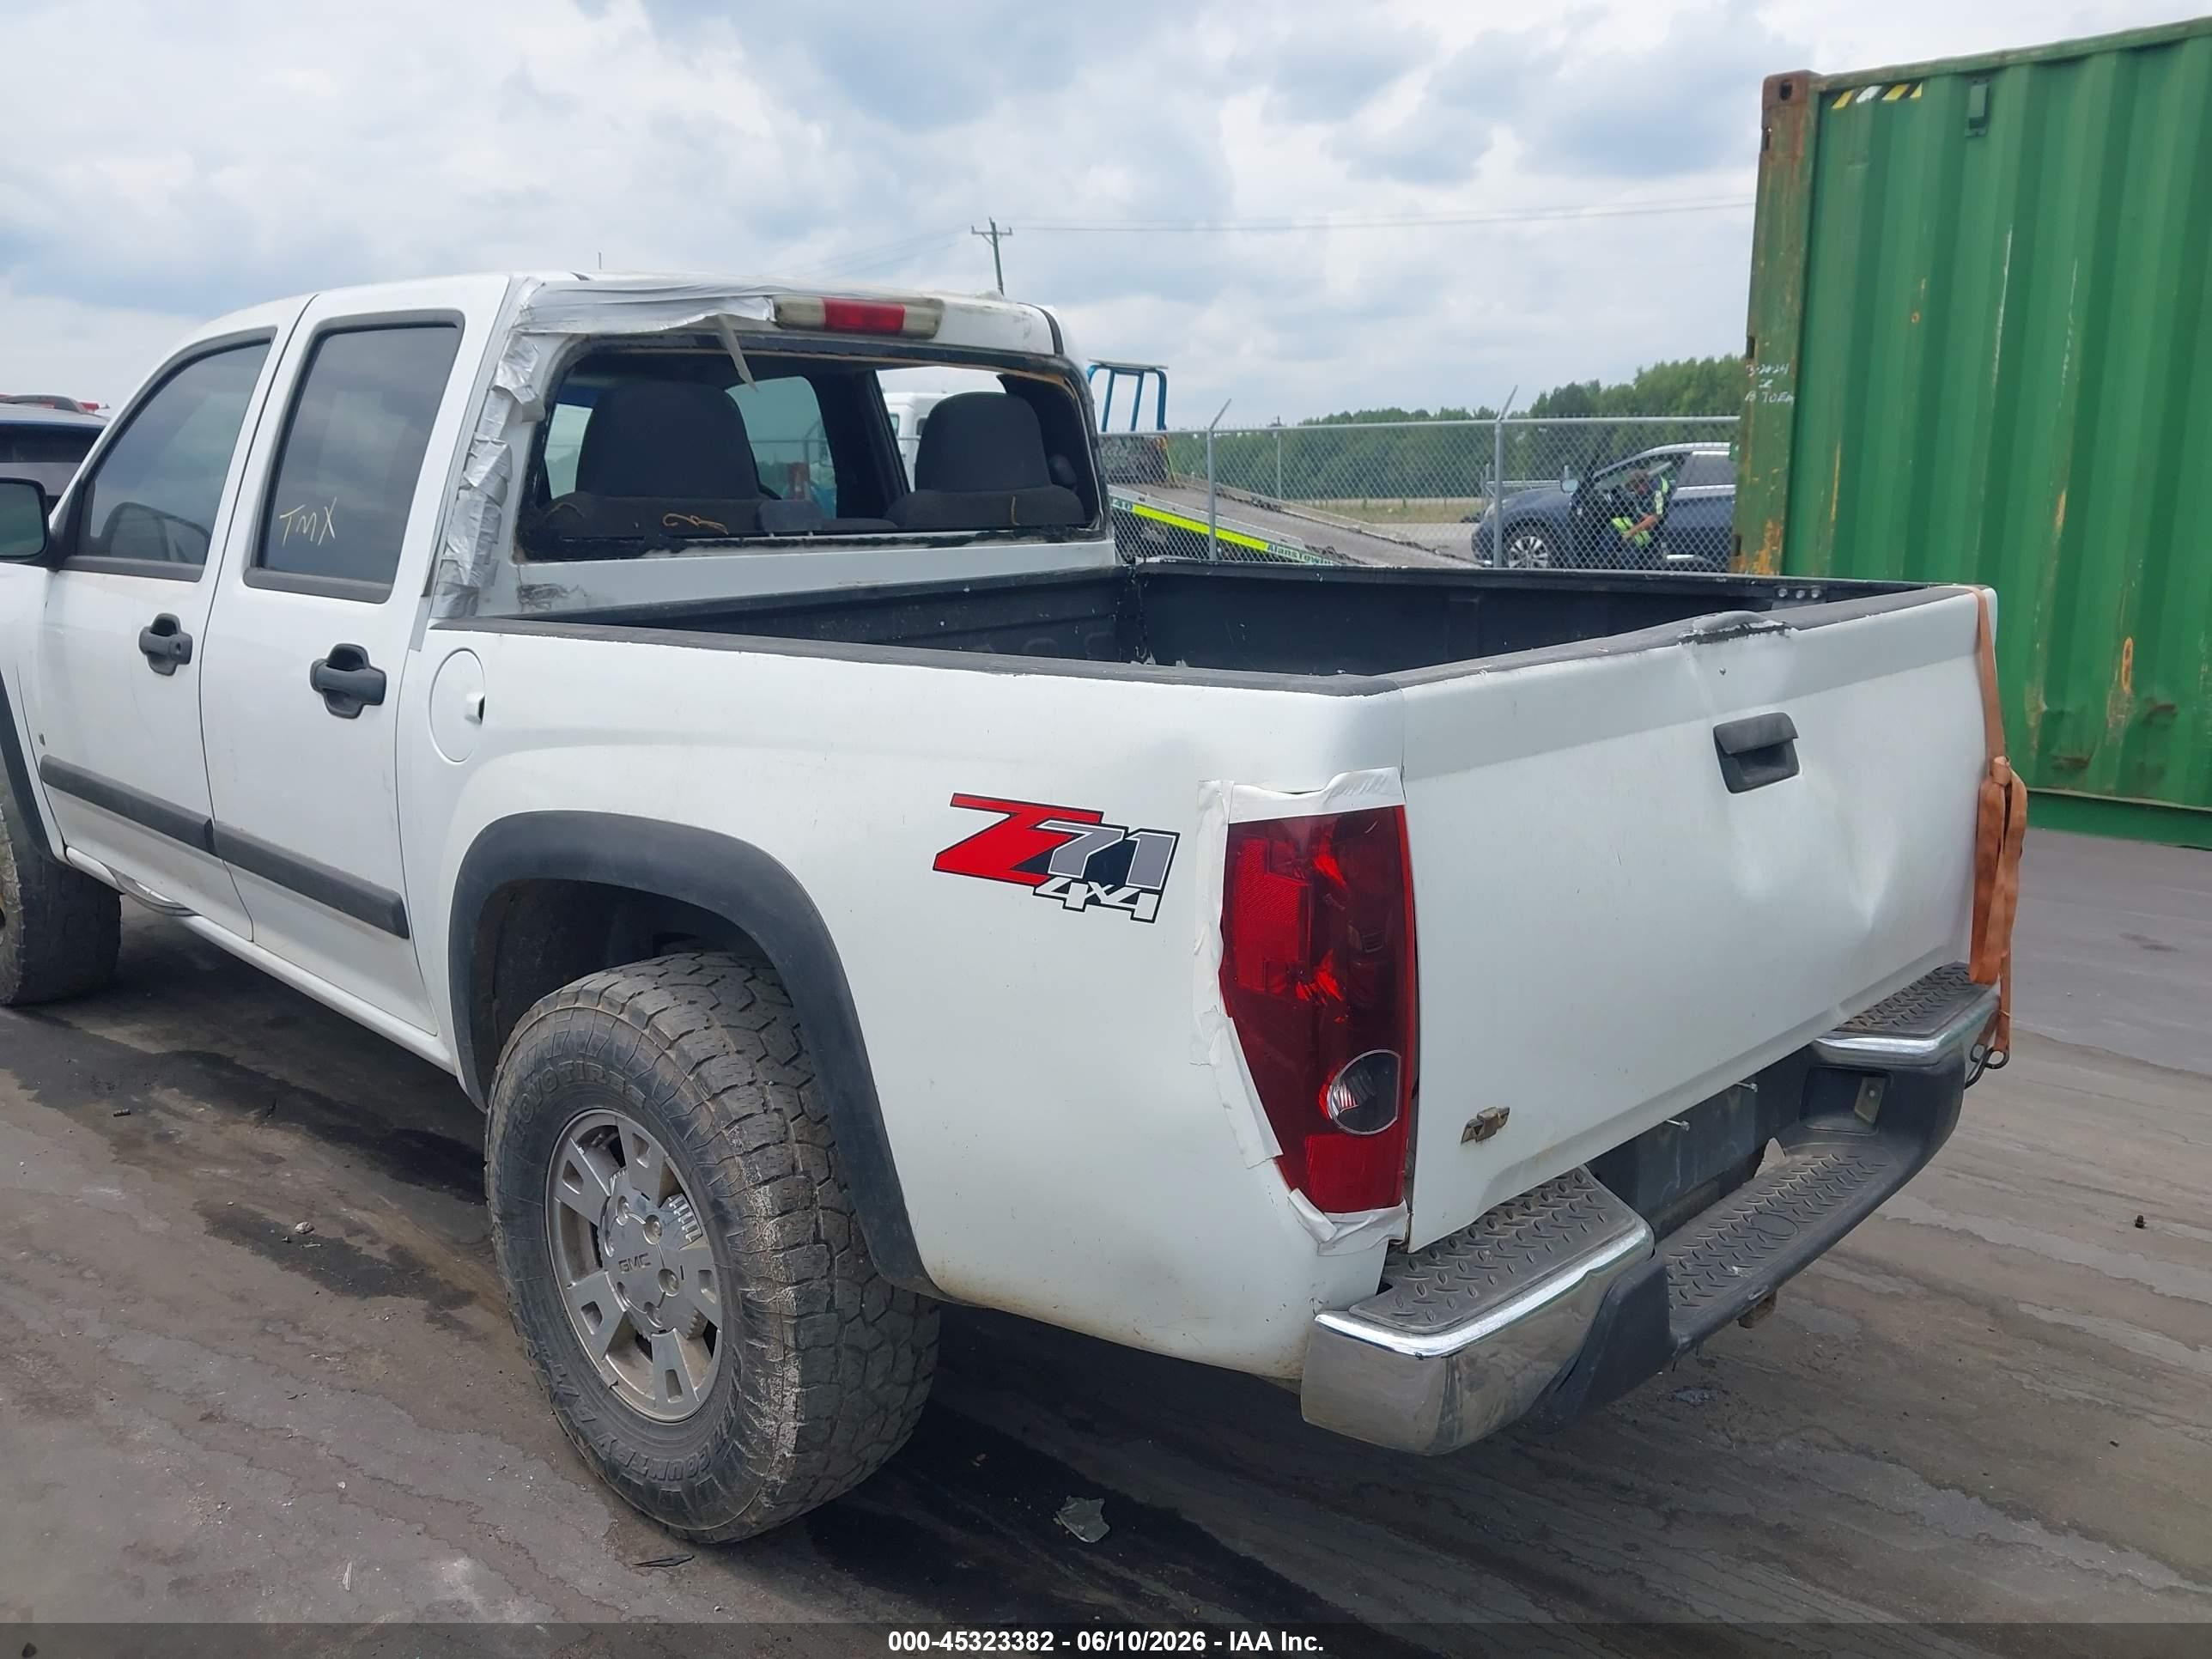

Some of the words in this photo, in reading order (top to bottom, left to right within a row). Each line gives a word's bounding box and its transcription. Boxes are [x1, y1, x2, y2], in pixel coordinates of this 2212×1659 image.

[279, 496, 337, 546] TMX
[933, 792, 1181, 891] Z71
[559, 1059, 647, 1111] TIRES
[618, 1253, 652, 1273] GMC
[596, 1431, 712, 1482] COUNTRY
